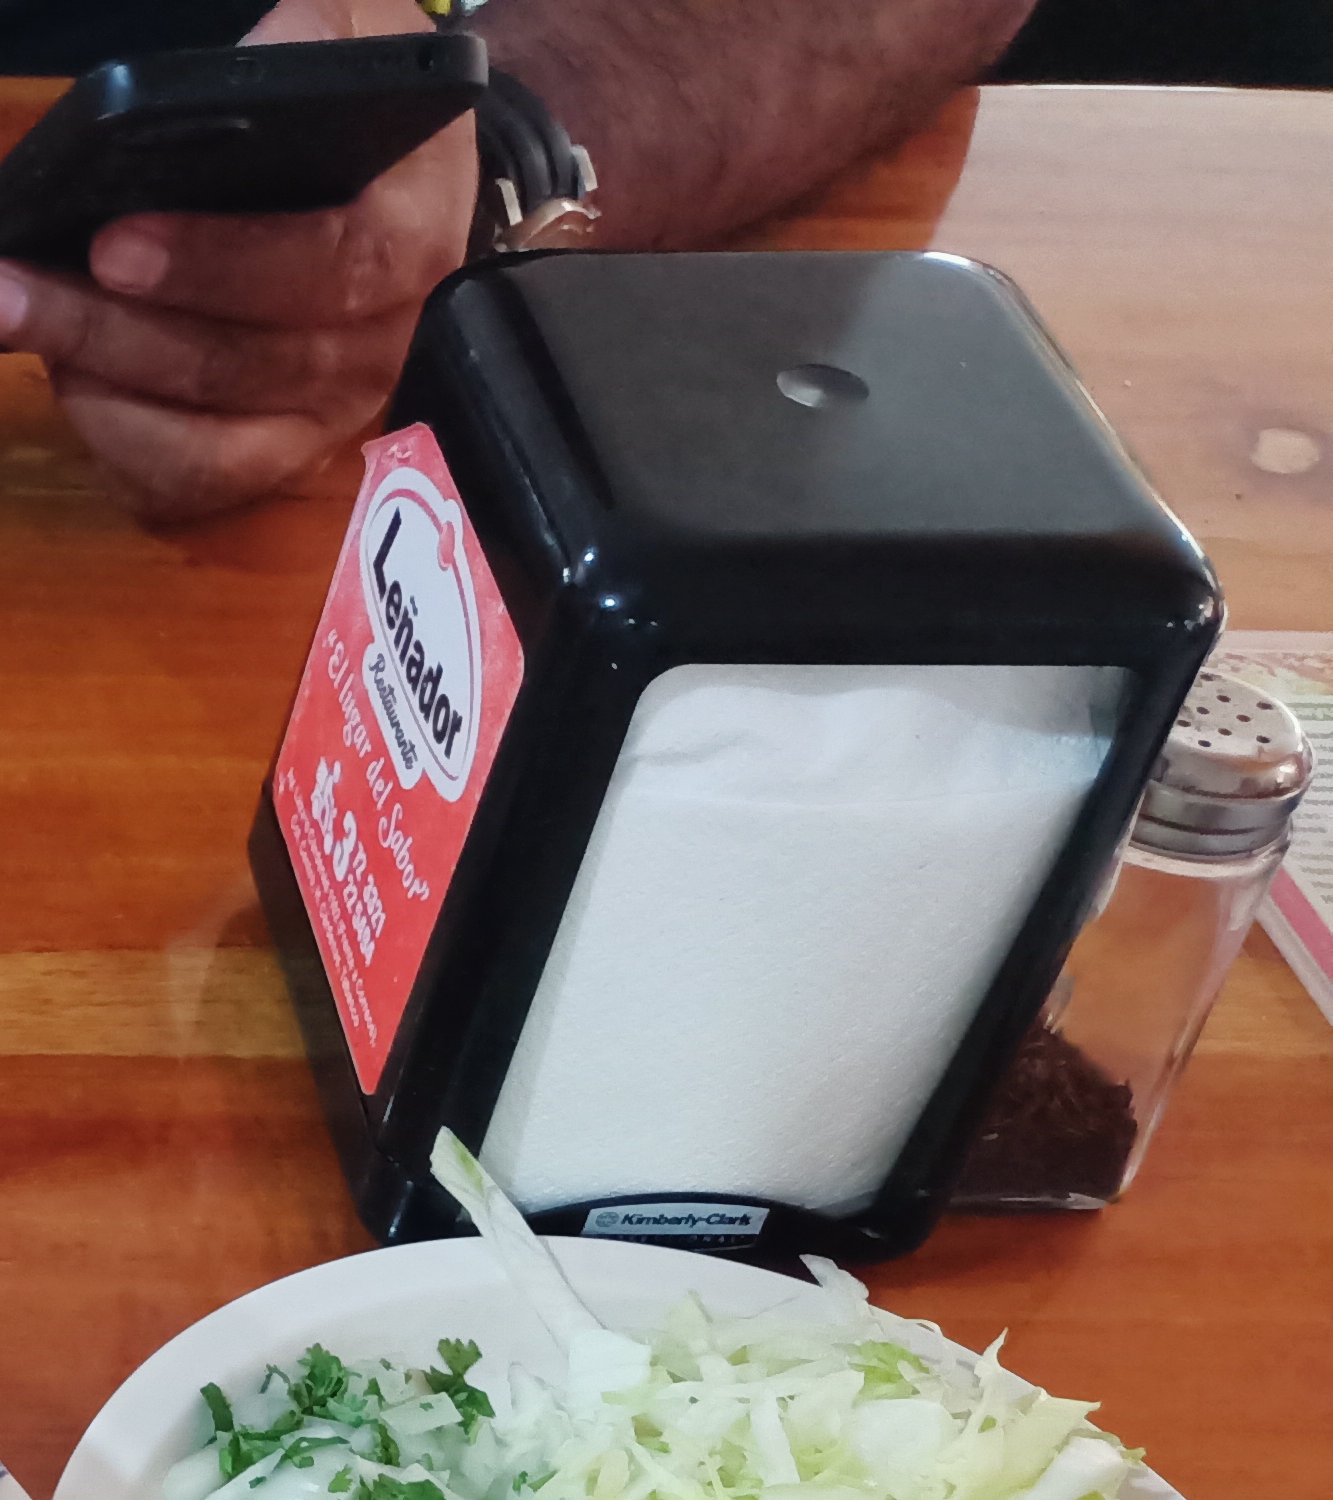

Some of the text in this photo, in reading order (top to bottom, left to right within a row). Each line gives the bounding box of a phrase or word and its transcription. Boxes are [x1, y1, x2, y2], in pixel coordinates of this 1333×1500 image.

[372, 506, 462, 758] Leñador
[337, 672, 372, 757] lugar
[365, 762, 393, 810] del
[368, 653, 418, 769] Restaurante
[332, 811, 357, 881] 3
[620, 1213, 753, 1228] Kimberly-Clark
